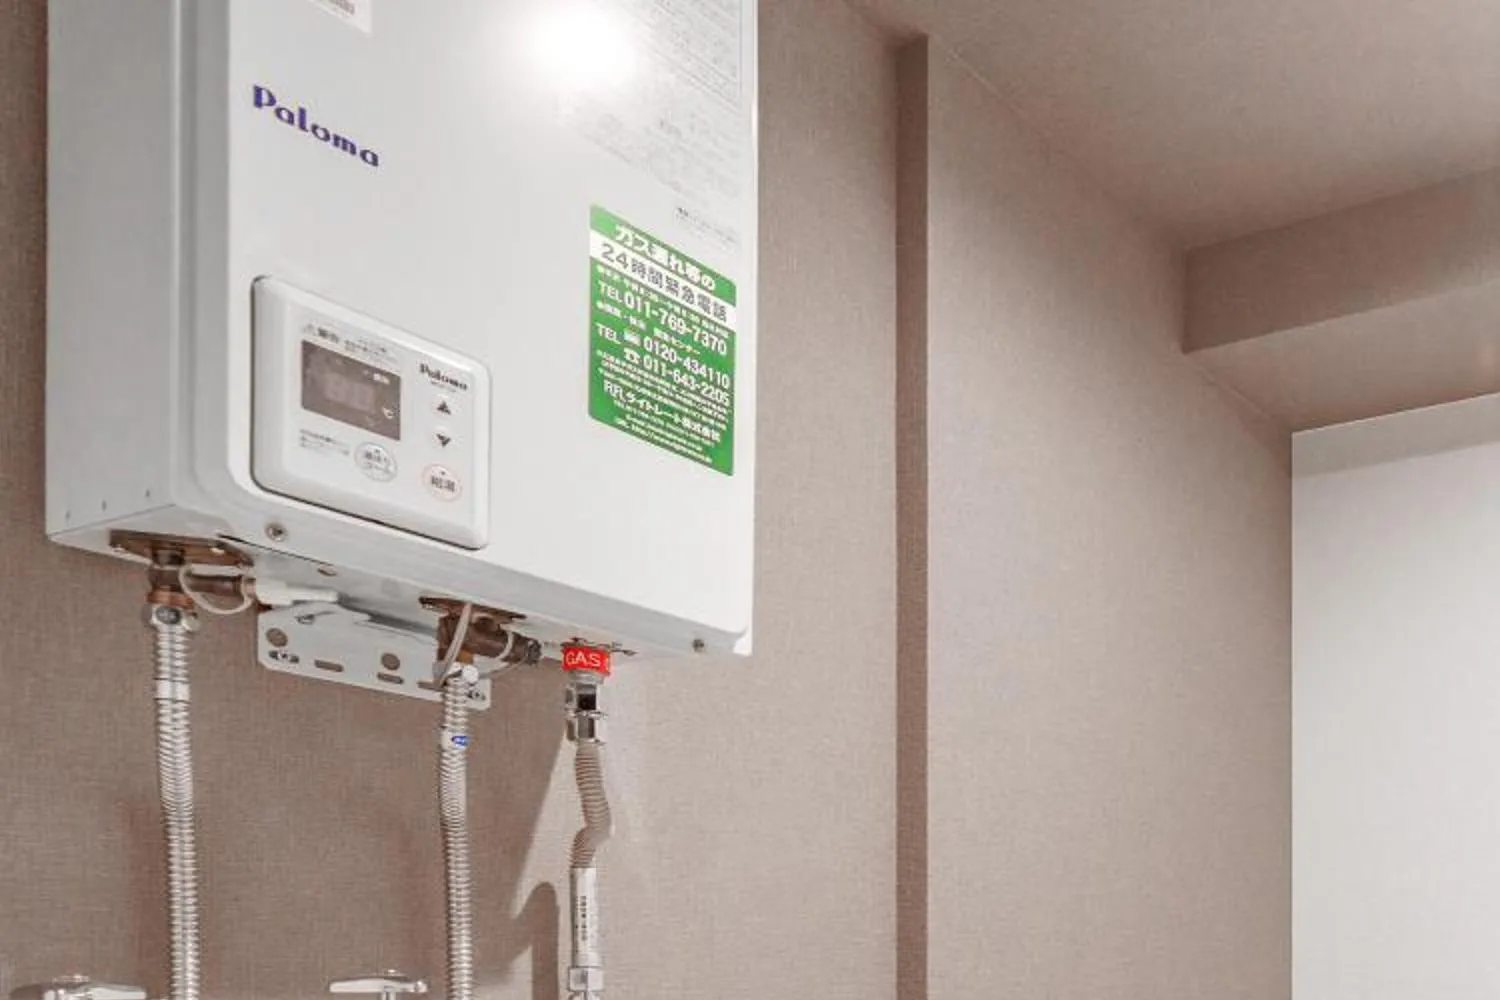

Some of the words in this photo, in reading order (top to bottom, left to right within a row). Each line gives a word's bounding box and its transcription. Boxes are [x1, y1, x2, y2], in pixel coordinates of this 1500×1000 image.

[252, 84, 379, 167] Paloma
[624, 290, 727, 356] 011-769-7370
[565, 650, 602, 668] GAS
